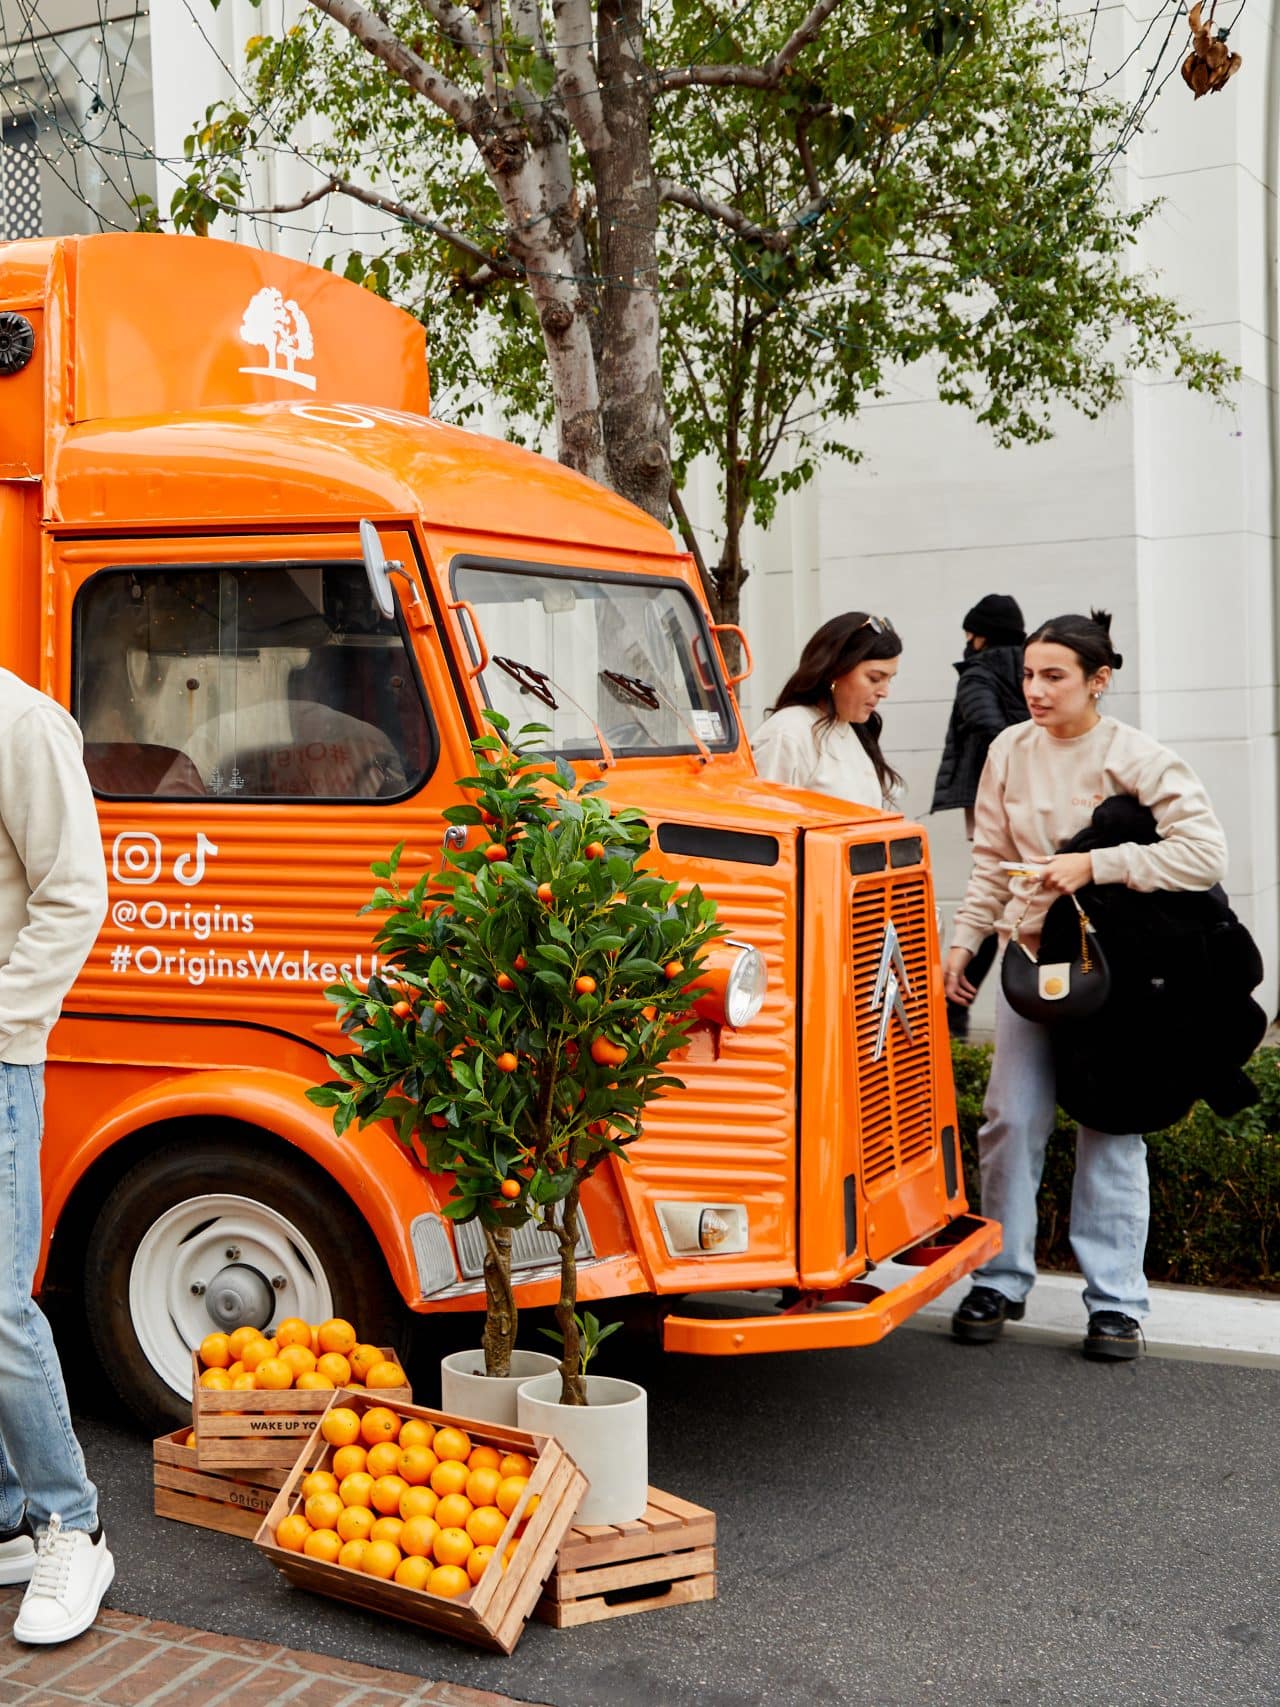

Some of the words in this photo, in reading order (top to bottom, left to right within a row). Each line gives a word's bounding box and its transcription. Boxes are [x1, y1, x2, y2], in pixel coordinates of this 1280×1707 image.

[111, 900, 255, 941] @Origins
[250, 1422, 283, 1431] WAKE
[285, 1422, 300, 1431] UP
